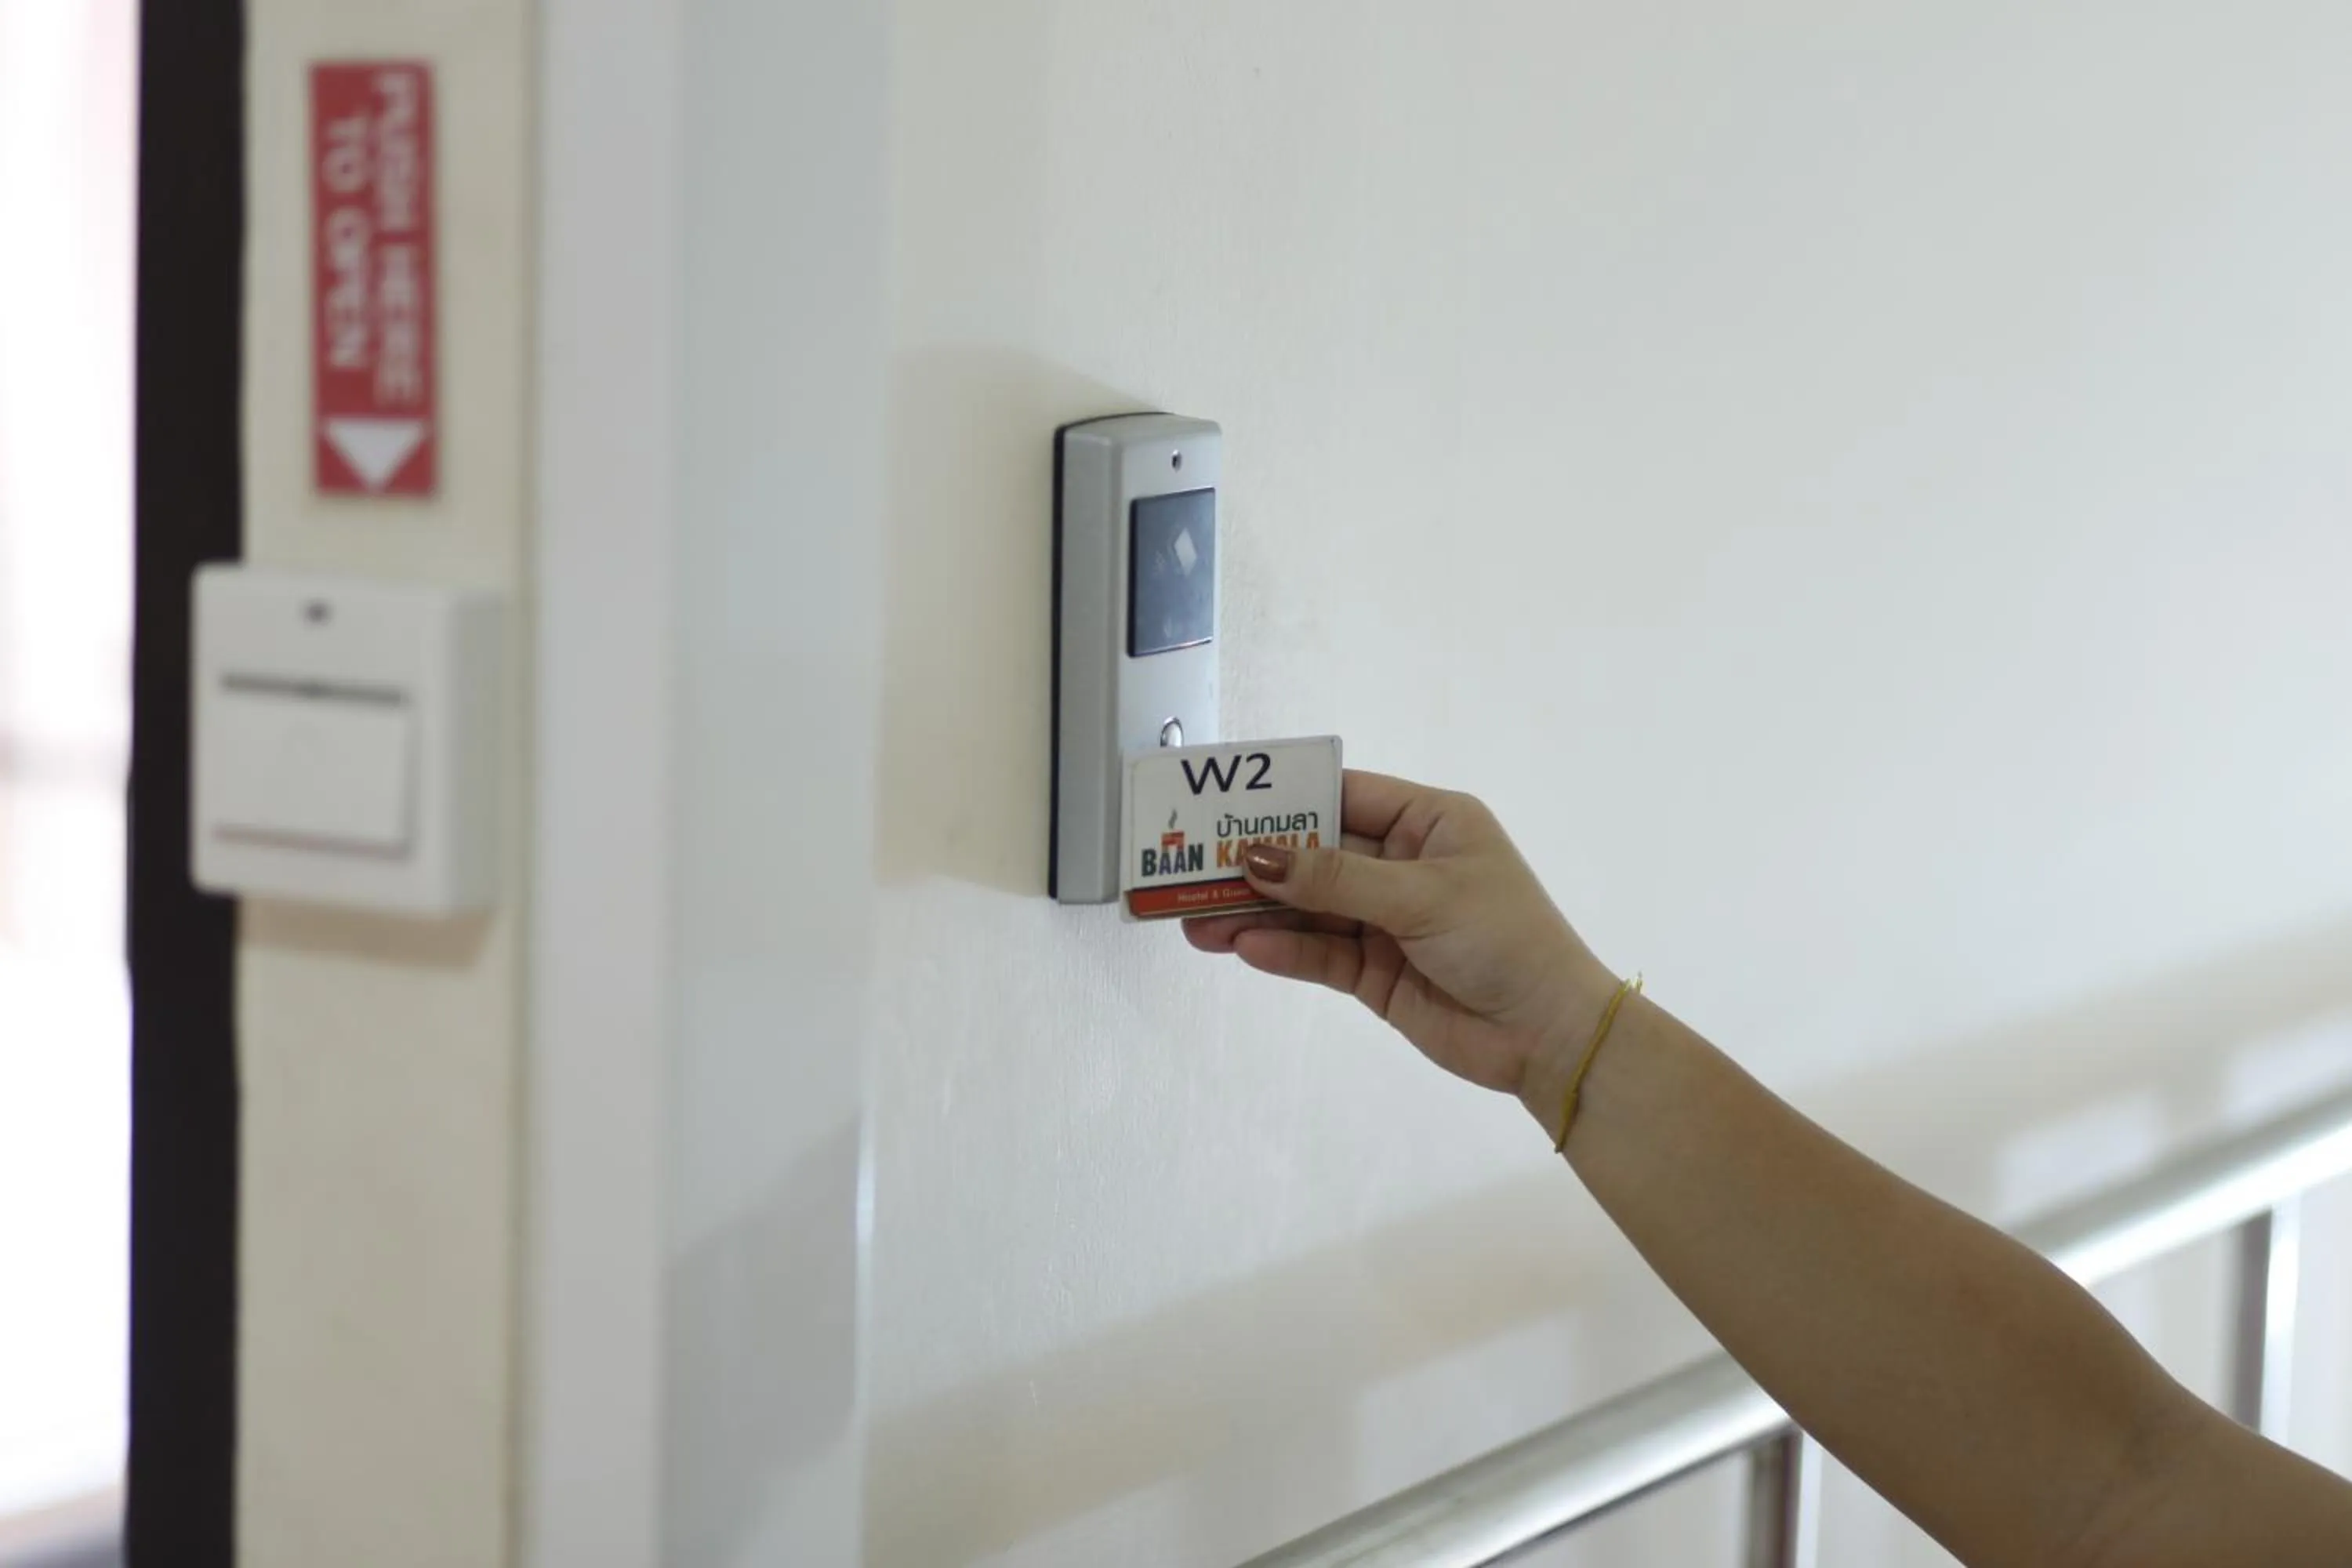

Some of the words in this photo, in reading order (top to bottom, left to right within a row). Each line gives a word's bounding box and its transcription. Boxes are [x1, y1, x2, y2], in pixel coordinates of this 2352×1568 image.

[321, 116, 369, 194] TO
[322, 204, 369, 368] OPEN
[1180, 752, 1273, 795] W2
[1216, 811, 1319, 837] บ้านกมลา
[1141, 843, 1203, 877] BAAN
